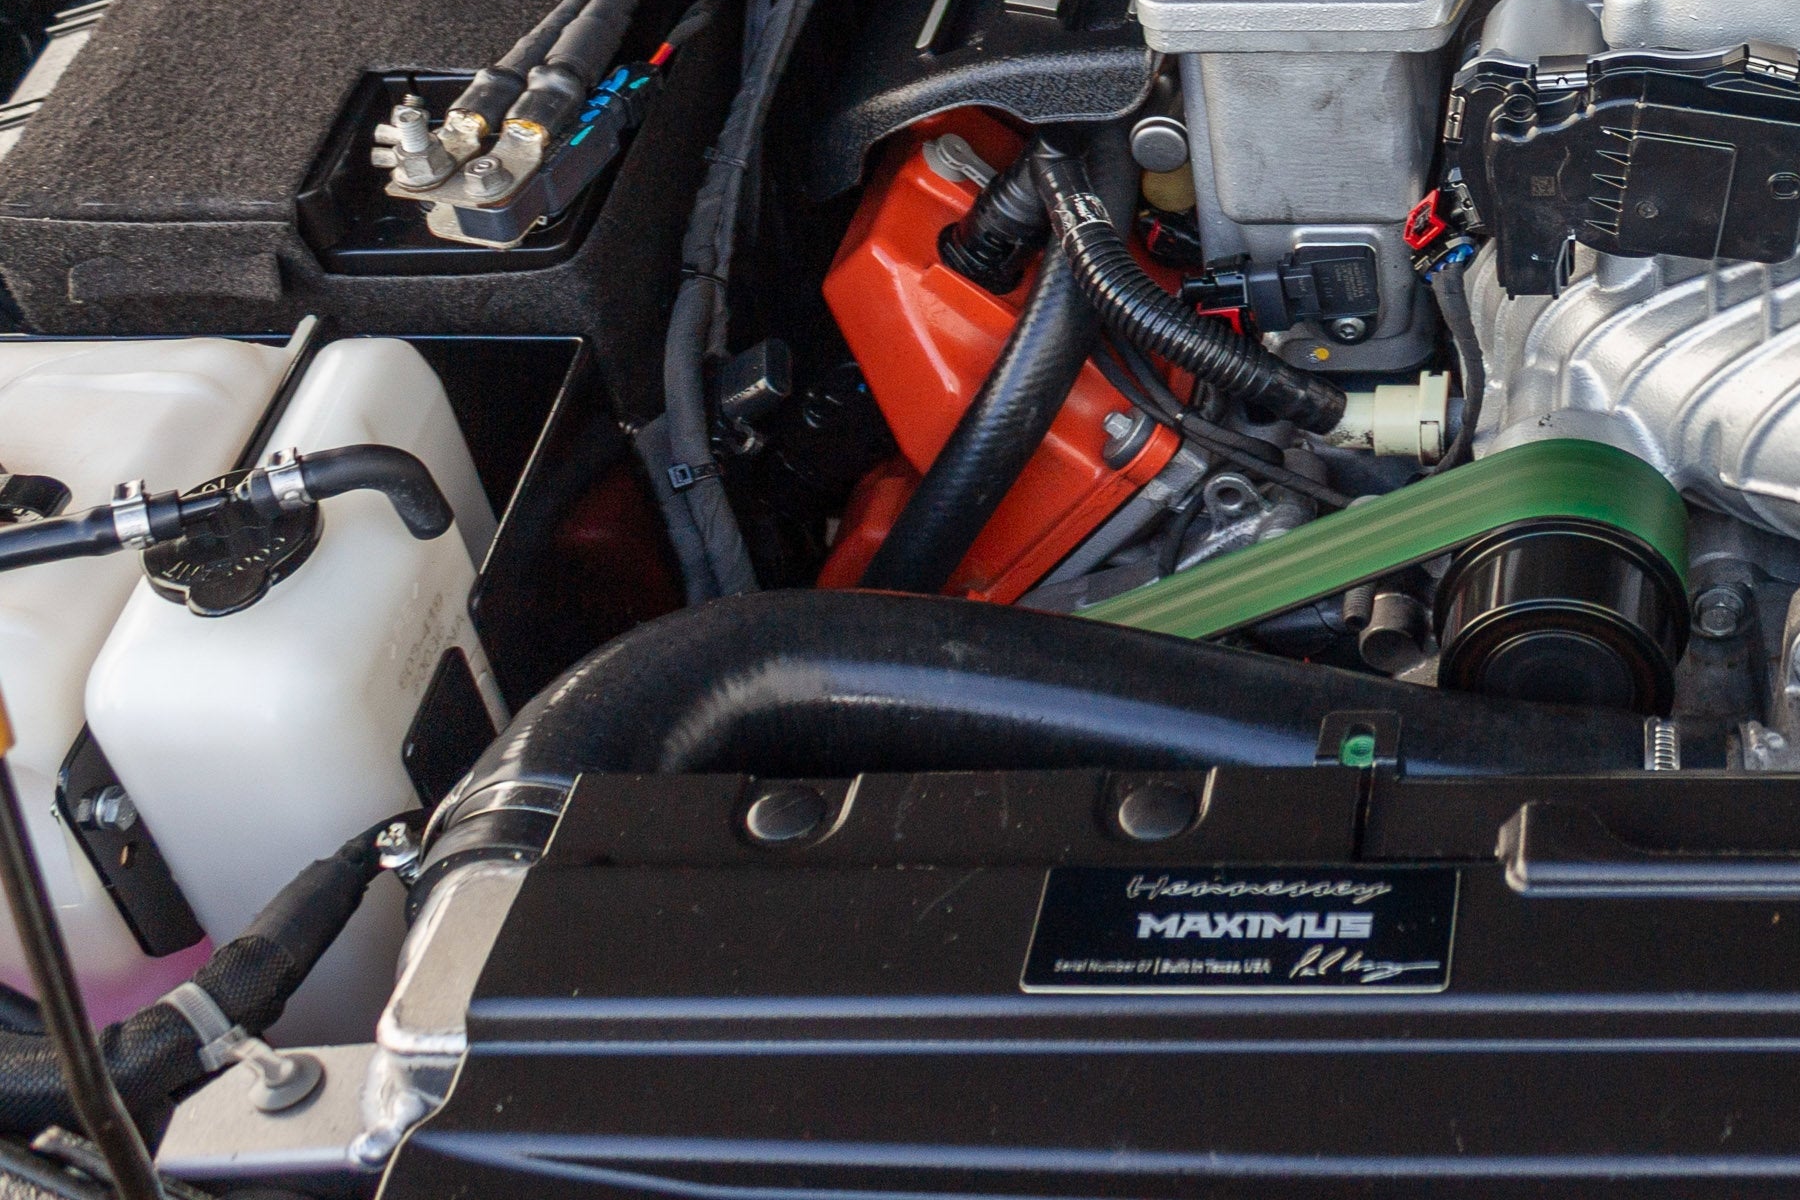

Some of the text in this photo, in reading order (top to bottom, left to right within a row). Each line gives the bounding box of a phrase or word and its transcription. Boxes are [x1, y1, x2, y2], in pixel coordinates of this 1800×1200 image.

[1126, 874, 1392, 905] Hennessey
[1136, 911, 1375, 939] MAXIMUS
[1053, 959, 1088, 973] Serial
[1087, 959, 1136, 973] Number
[1243, 958, 1272, 974] USA
